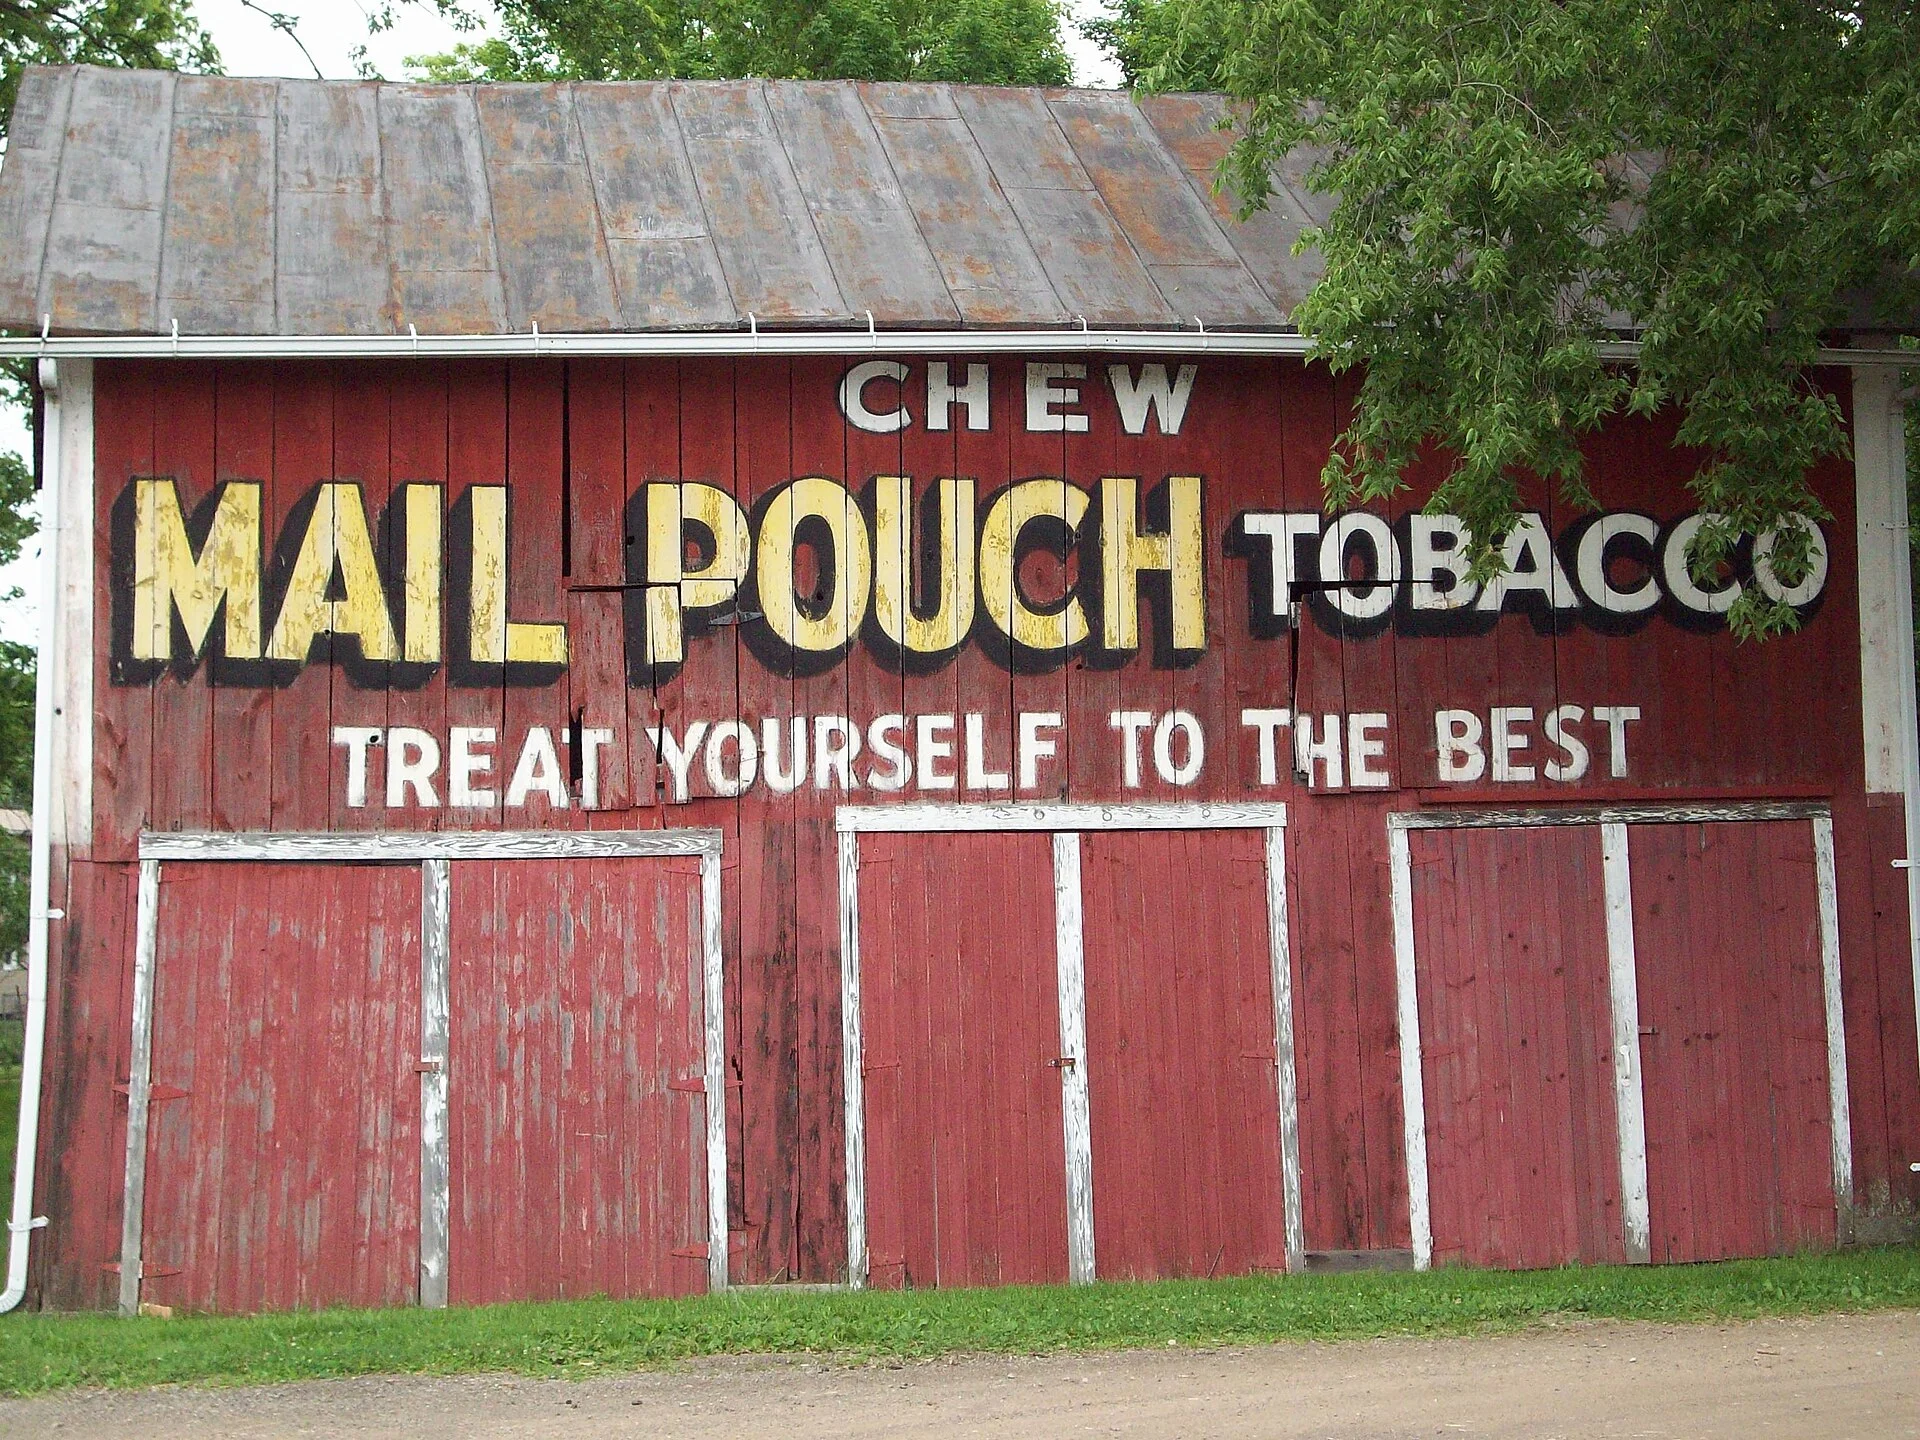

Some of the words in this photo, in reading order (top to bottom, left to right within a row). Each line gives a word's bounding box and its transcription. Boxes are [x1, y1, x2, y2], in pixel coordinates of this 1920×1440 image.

[839, 360, 1198, 435] CHEW
[132, 479, 568, 664] MAIL
[645, 475, 1206, 663] POUCH
[1243, 511, 1828, 618] TOBACCO
[332, 725, 614, 810] TREAT
[645, 711, 1064, 804] YOURSELF
[1108, 709, 1206, 788] TO
[1242, 707, 1390, 790] THE
[1435, 704, 1641, 783] BEST
